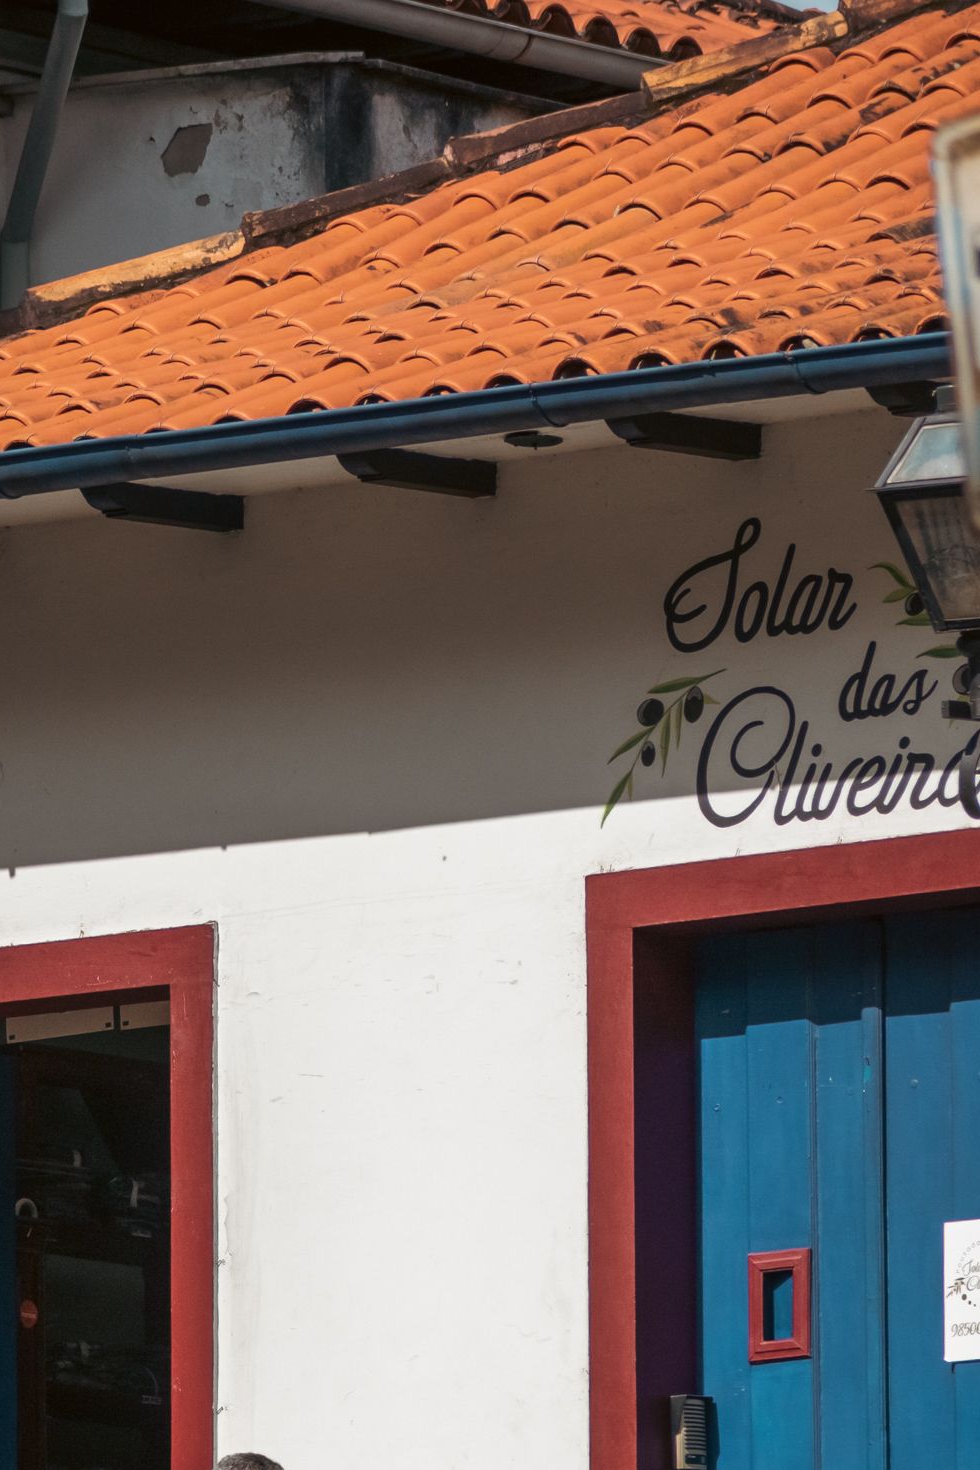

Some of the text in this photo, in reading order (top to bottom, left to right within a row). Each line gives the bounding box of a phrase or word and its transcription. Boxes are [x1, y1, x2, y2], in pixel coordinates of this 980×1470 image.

[663, 517, 857, 652] Solar
[839, 640, 938, 721] das
[696, 686, 968, 828] Oliveira
